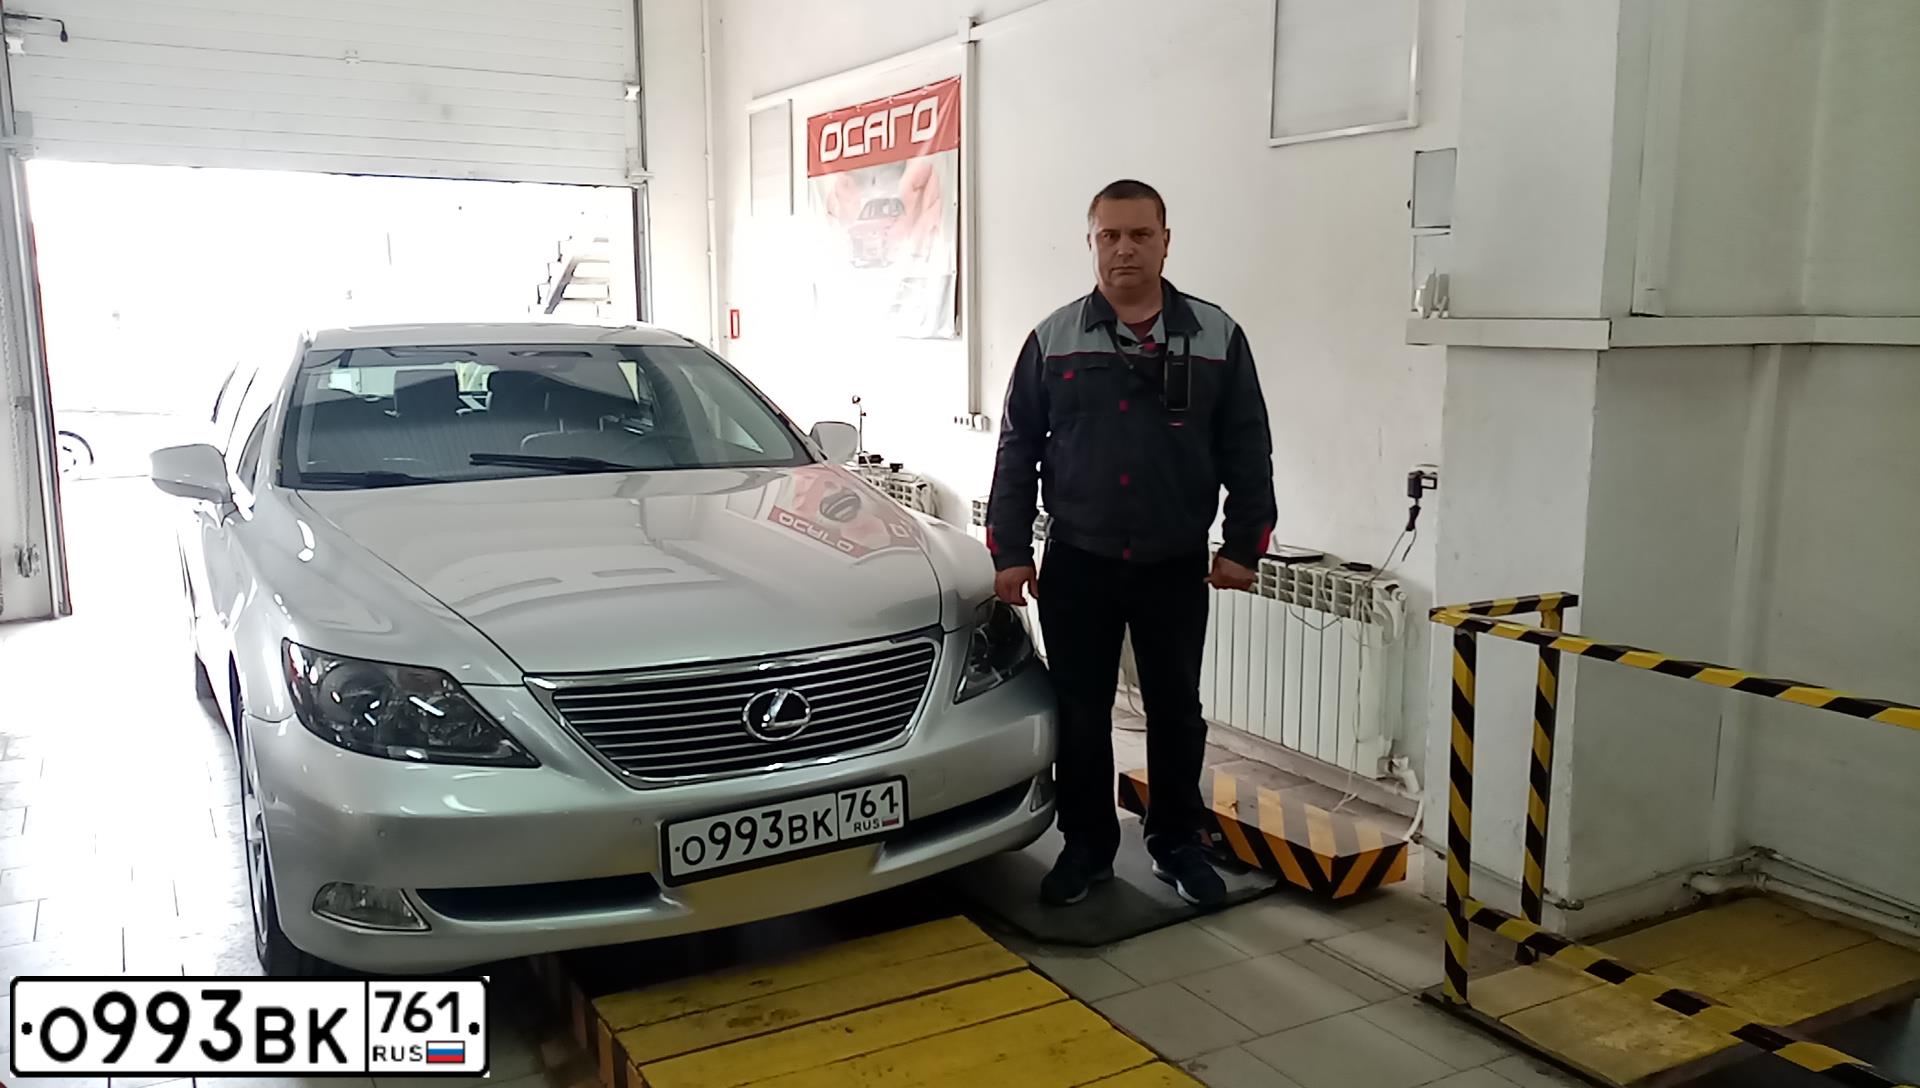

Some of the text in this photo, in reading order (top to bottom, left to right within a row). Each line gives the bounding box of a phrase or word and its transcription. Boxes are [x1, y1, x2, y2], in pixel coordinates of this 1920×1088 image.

[819, 96, 939, 163] ОСАГО
[841, 786, 896, 823] 761
[853, 818, 880, 833] RUS
